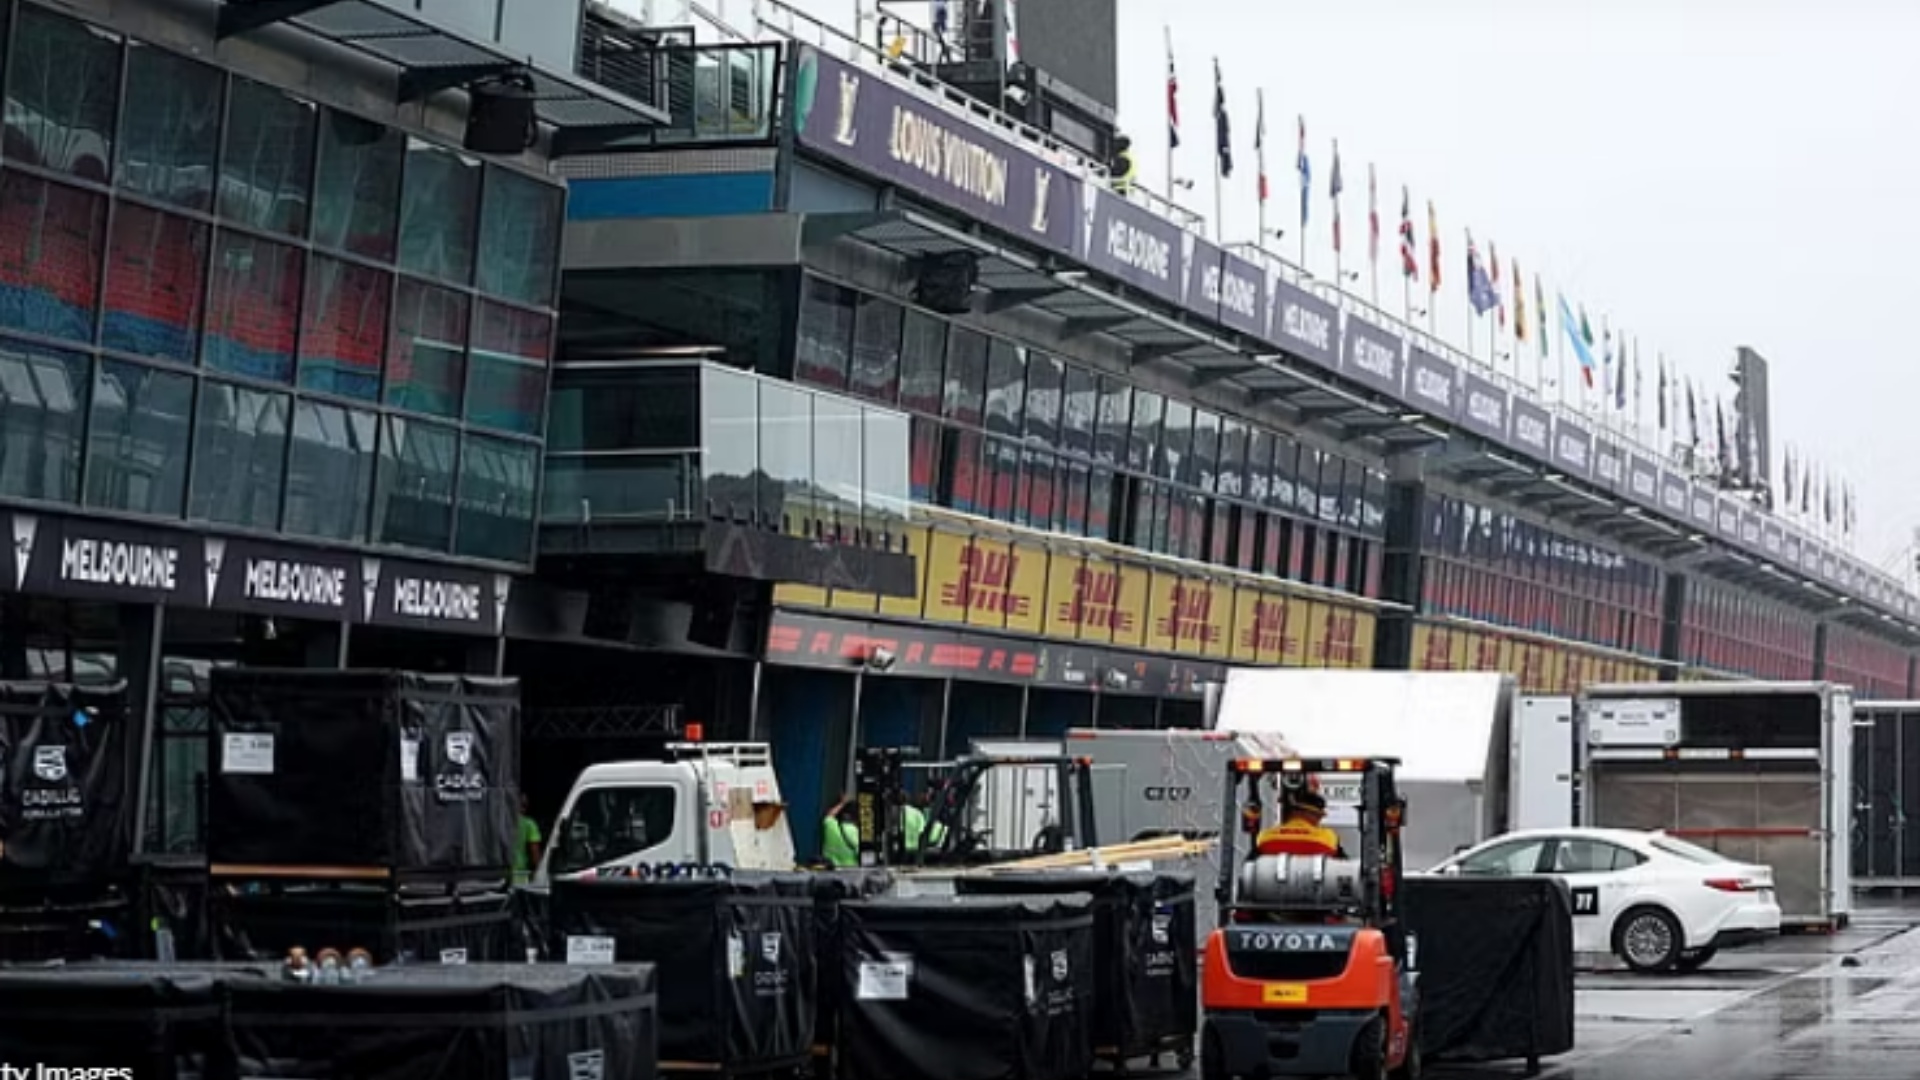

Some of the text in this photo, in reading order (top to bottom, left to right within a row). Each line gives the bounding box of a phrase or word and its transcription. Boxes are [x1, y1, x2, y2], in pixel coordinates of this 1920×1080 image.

[891, 104, 1007, 206] LOUIS VUITTON
[1108, 217, 1170, 281] MELBOURNE
[61, 537, 178, 590] MELBOURNE
[245, 557, 345, 606] MELBOURNE
[944, 544, 1026, 615] DHL
[394, 576, 480, 621] MELBOURNE
[1240, 934, 1335, 949] TOYOTA
